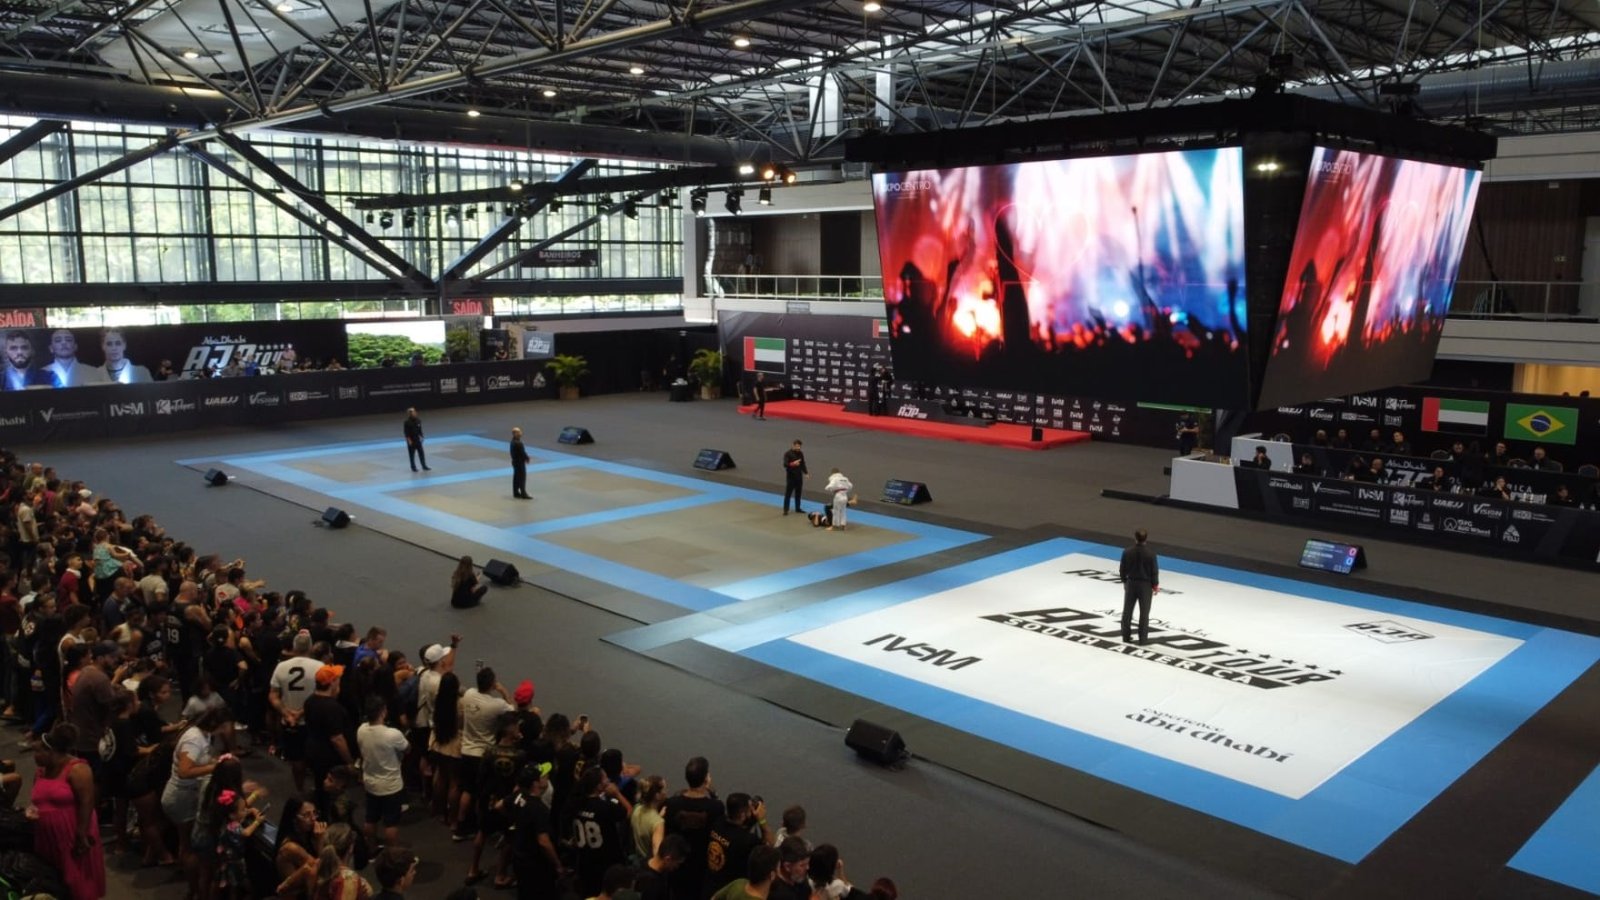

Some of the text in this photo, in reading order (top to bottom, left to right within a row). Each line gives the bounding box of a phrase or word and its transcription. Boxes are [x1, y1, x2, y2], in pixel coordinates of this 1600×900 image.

[538, 251, 581, 259] BANHEIROS
[0, 309, 36, 328] SAÍDA
[453, 300, 483, 315] SAÍDA
[167, 628, 180, 643] 19
[1008, 607, 1336, 685] AJP TOUR
[862, 633, 983, 671] IVSM
[1003, 617, 1253, 685] SOUTH AMERICA
[288, 666, 305, 691] 2
[1142, 708, 1224, 731] experience
[1125, 713, 1294, 763] abu dhabi
